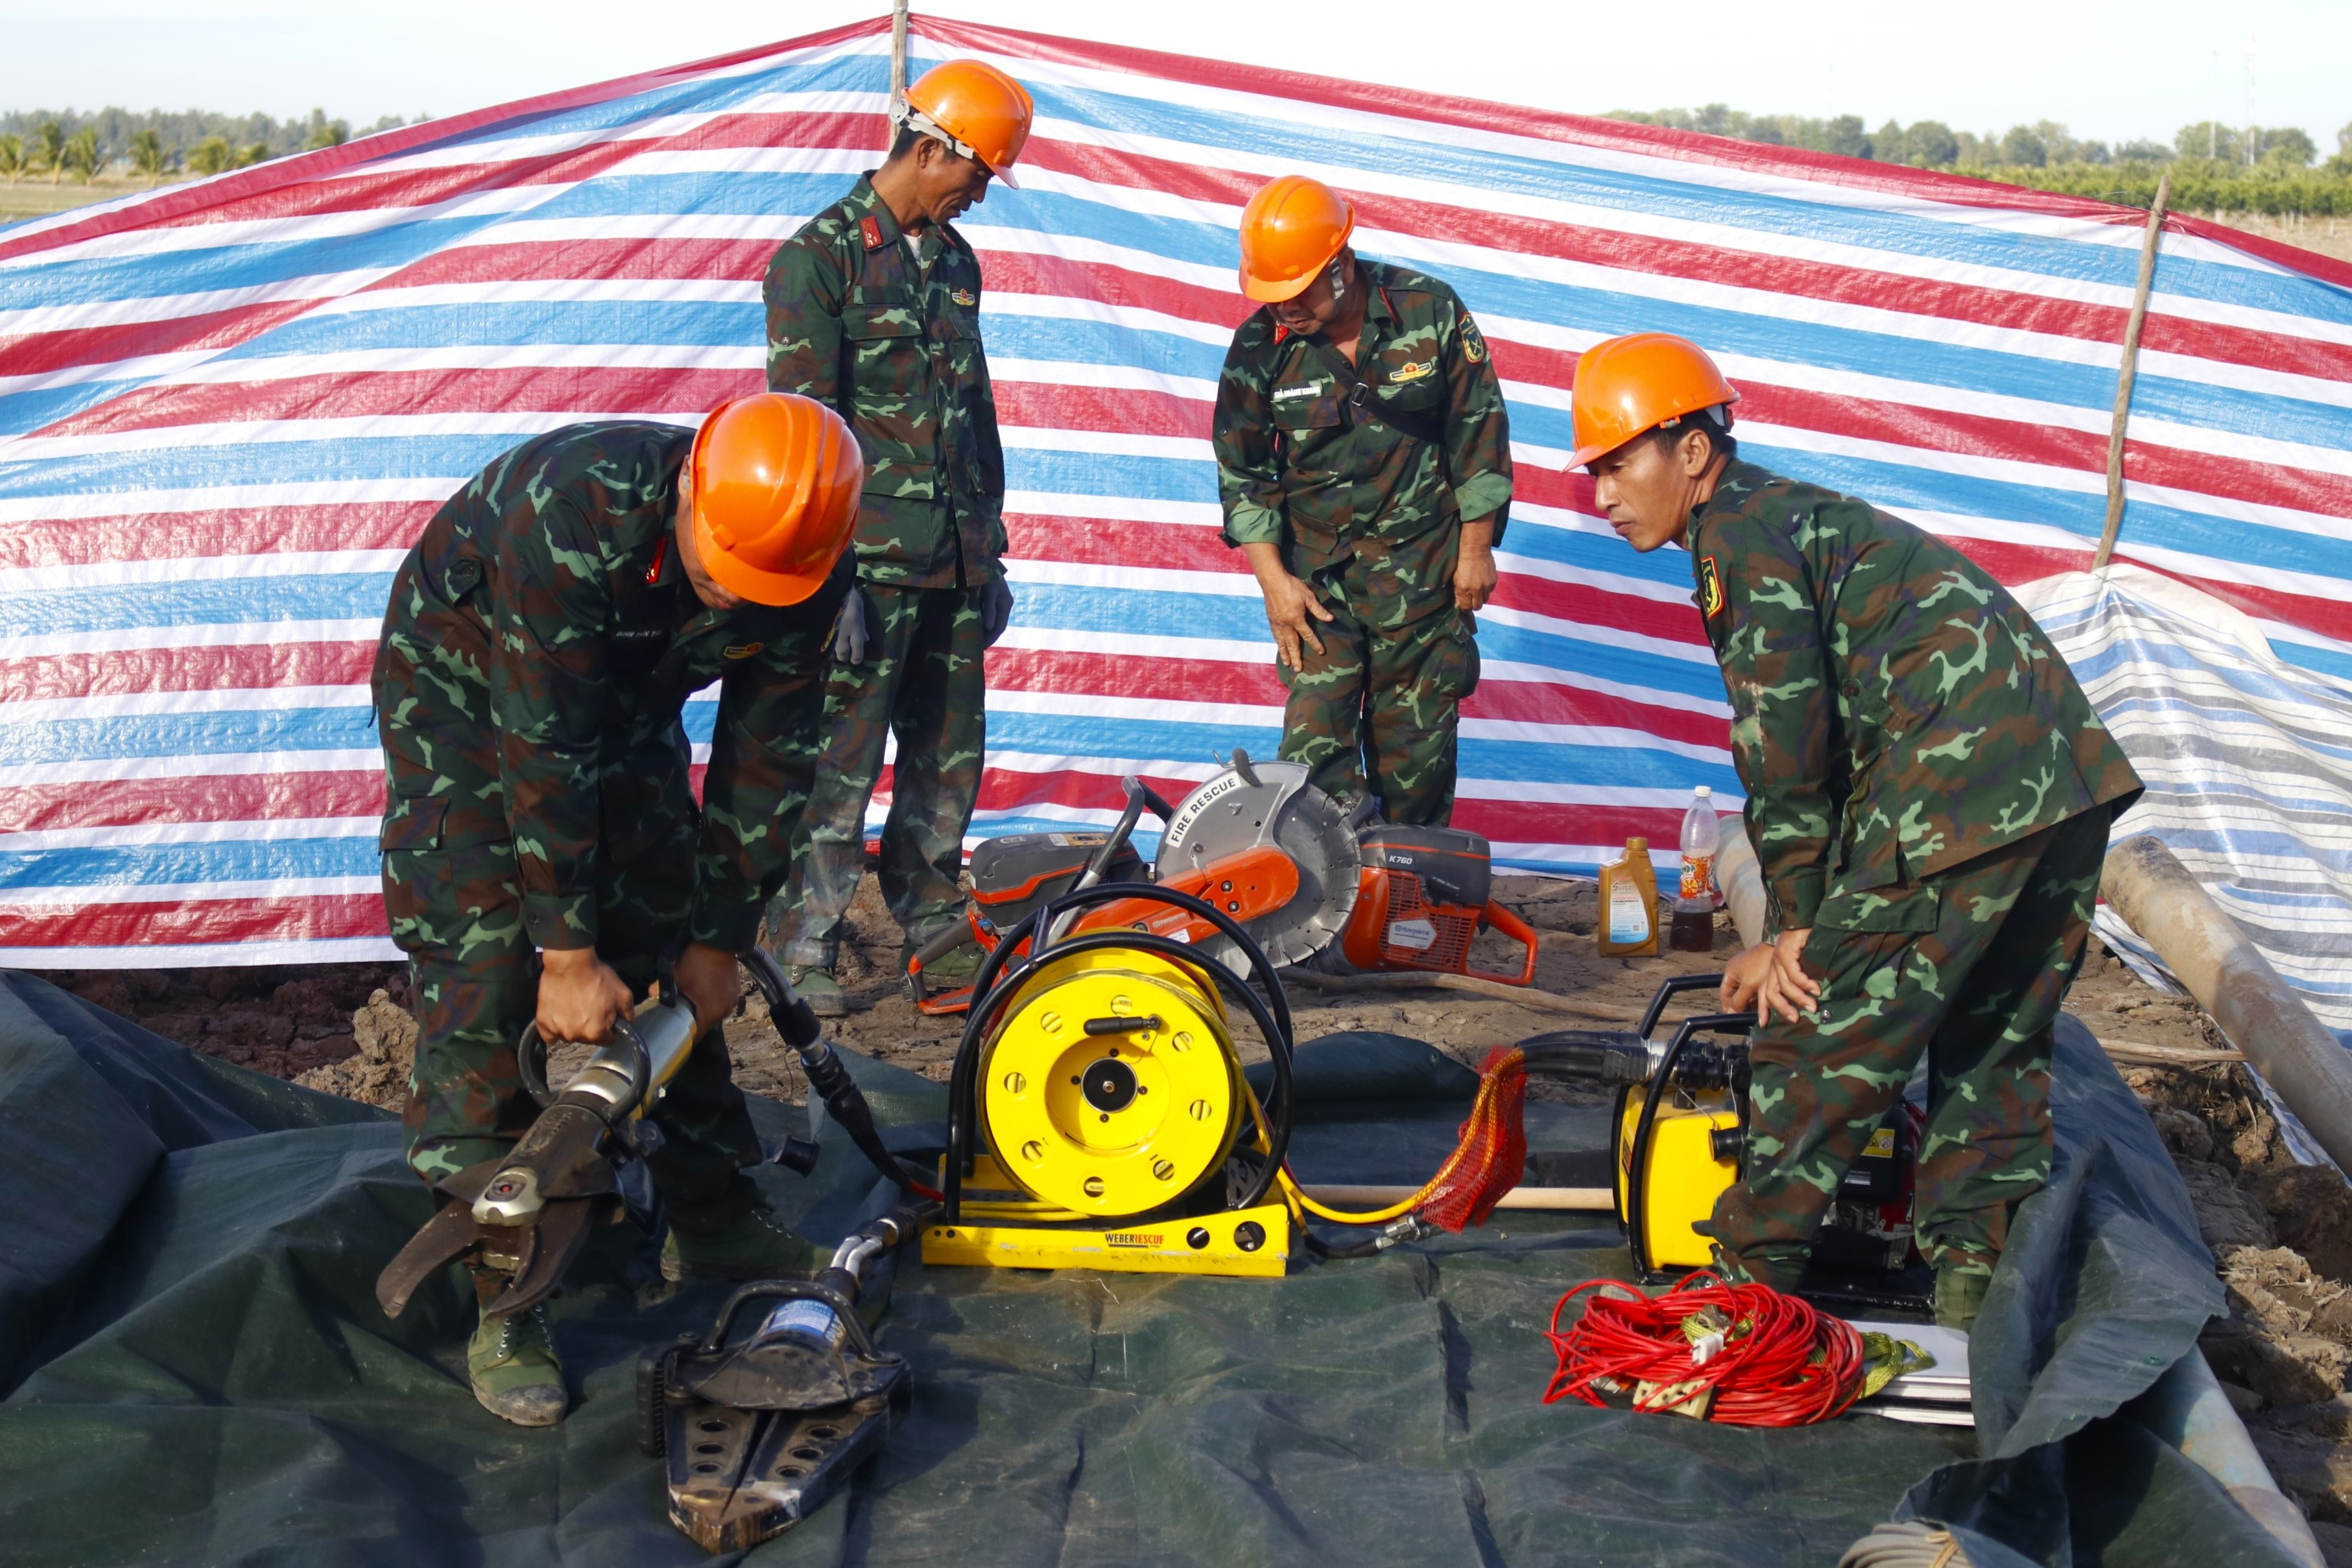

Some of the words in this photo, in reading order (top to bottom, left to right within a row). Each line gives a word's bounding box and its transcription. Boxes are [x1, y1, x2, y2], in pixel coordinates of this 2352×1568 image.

[1301, 386, 1321, 395] KHANG
[1170, 814, 1191, 842] FIRE
[1190, 778, 1236, 814] RESCUE
[1401, 925, 1430, 936] Husqvarna
